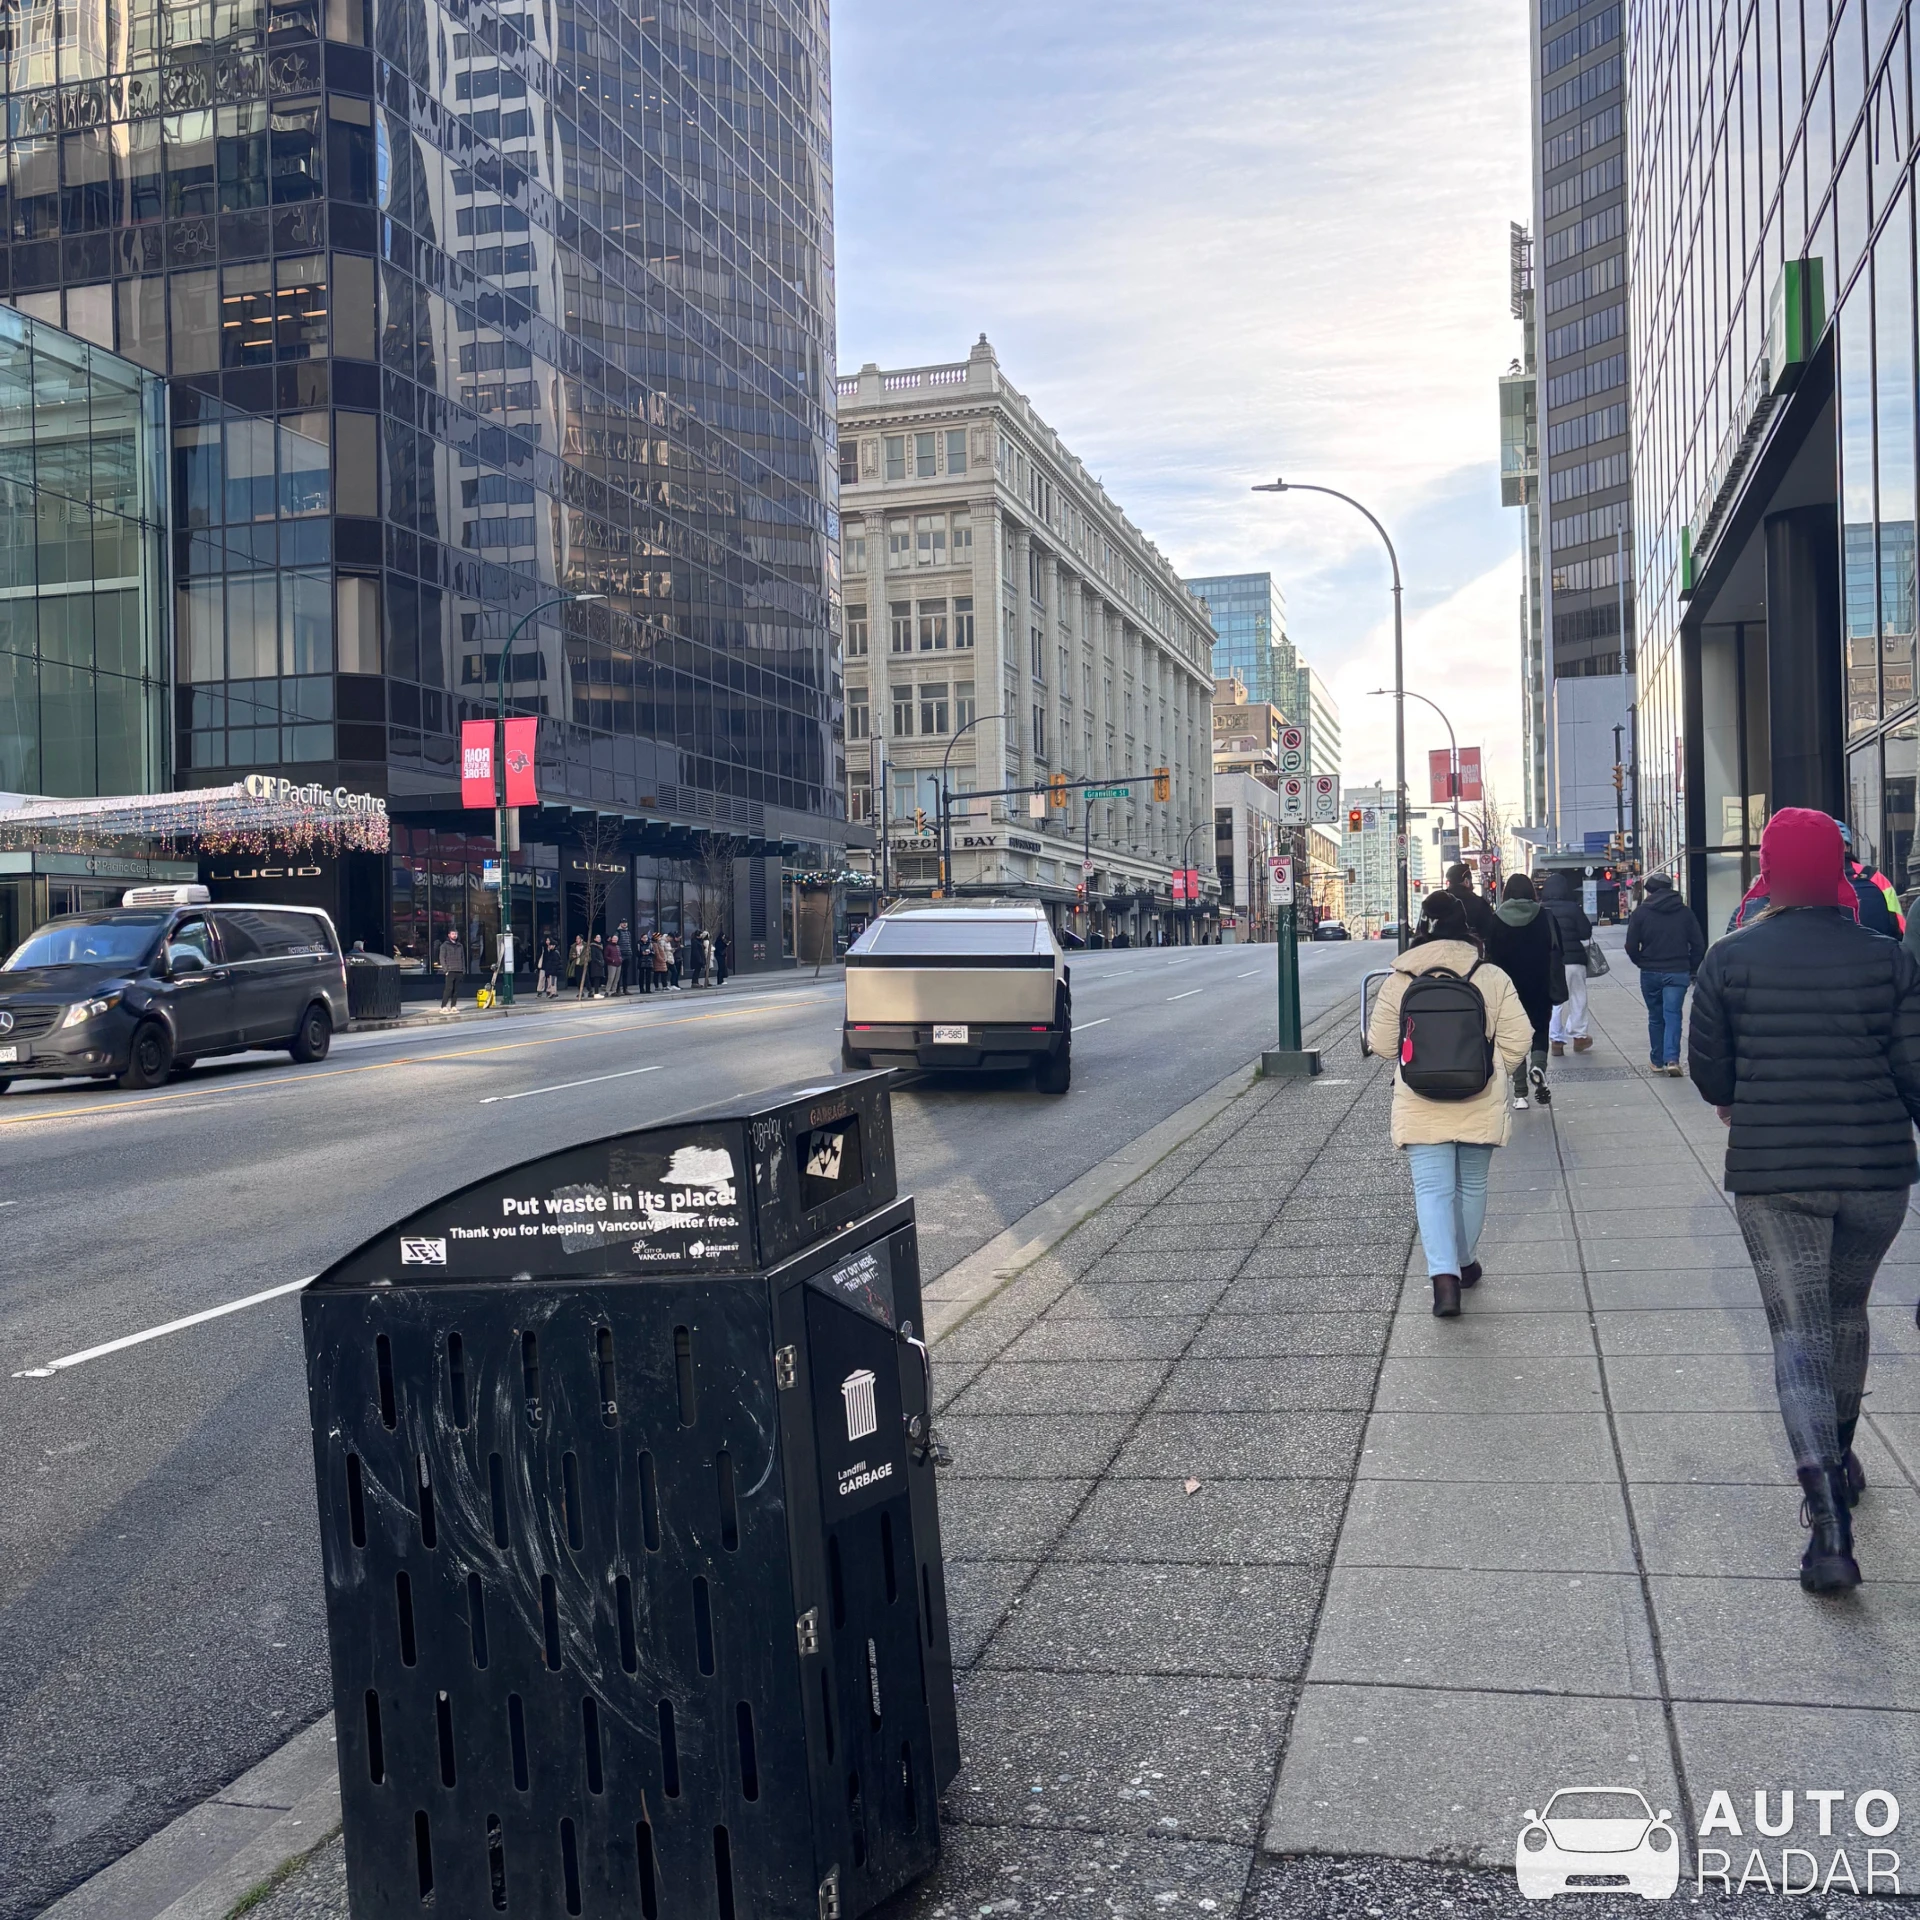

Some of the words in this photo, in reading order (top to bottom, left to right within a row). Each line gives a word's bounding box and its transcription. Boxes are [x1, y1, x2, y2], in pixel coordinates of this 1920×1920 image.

[244, 774, 277, 798] CF
[278, 778, 332, 807] Pacific
[334, 786, 386, 813] Centre
[1088, 790, 1117, 798] Granville
[963, 836, 998, 846] BAY
[86, 860, 100, 871] CF
[102, 860, 128, 873] Pacific
[130, 862, 157, 874] Centre
[210, 866, 322, 880] LUCID
[572, 860, 626, 873] LUCID
[810, 1103, 847, 1125] GARBAGE
[503, 1197, 540, 1216] Put
[544, 1194, 608, 1214] waste
[612, 1191, 633, 1211] in
[638, 1190, 666, 1210] its
[670, 1187, 737, 1211] place!
[450, 1226, 489, 1239] Thank
[492, 1227, 516, 1239] you
[519, 1224, 539, 1236] for
[542, 1222, 594, 1236] keeping
[672, 1218, 704, 1229] litter
[708, 1215, 739, 1228] free.
[832, 1268, 849, 1285] BUTT
[847, 1262, 860, 1276] OUT
[858, 1254, 878, 1270] HERE,
[838, 1460, 866, 1480] Landfill
[839, 1462, 892, 1495] GARBAGE
